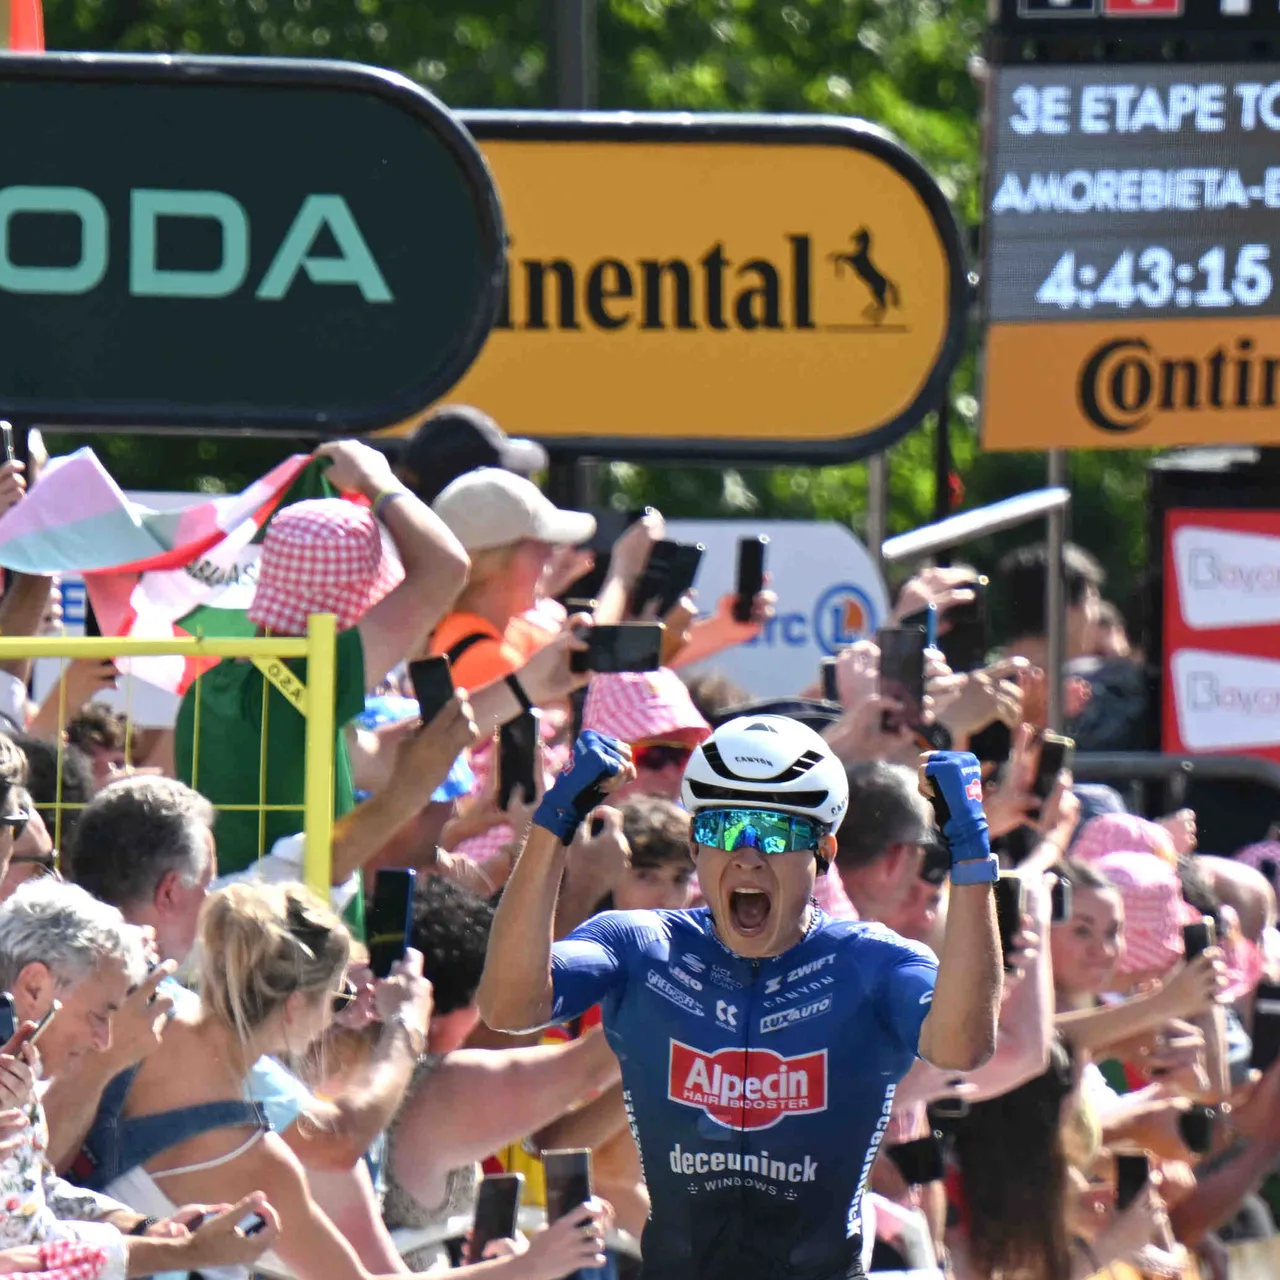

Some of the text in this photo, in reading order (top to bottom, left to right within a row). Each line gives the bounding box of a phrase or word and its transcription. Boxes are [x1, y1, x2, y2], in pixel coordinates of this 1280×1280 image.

[1010, 84, 1071, 134] 3E
[1079, 82, 1224, 133] ETAPE
[498, 234, 816, 331] inental
[1035, 245, 1271, 308] 4:43:15
[734, 756, 774, 767] CANYON
[787, 953, 837, 982] ZWIFT
[683, 1089, 809, 1109] HAIR BOOSTER
[684, 1057, 809, 1106] Alpecin
[670, 1143, 819, 1183] deceuninck
[704, 1177, 778, 1196] WINDOWS
